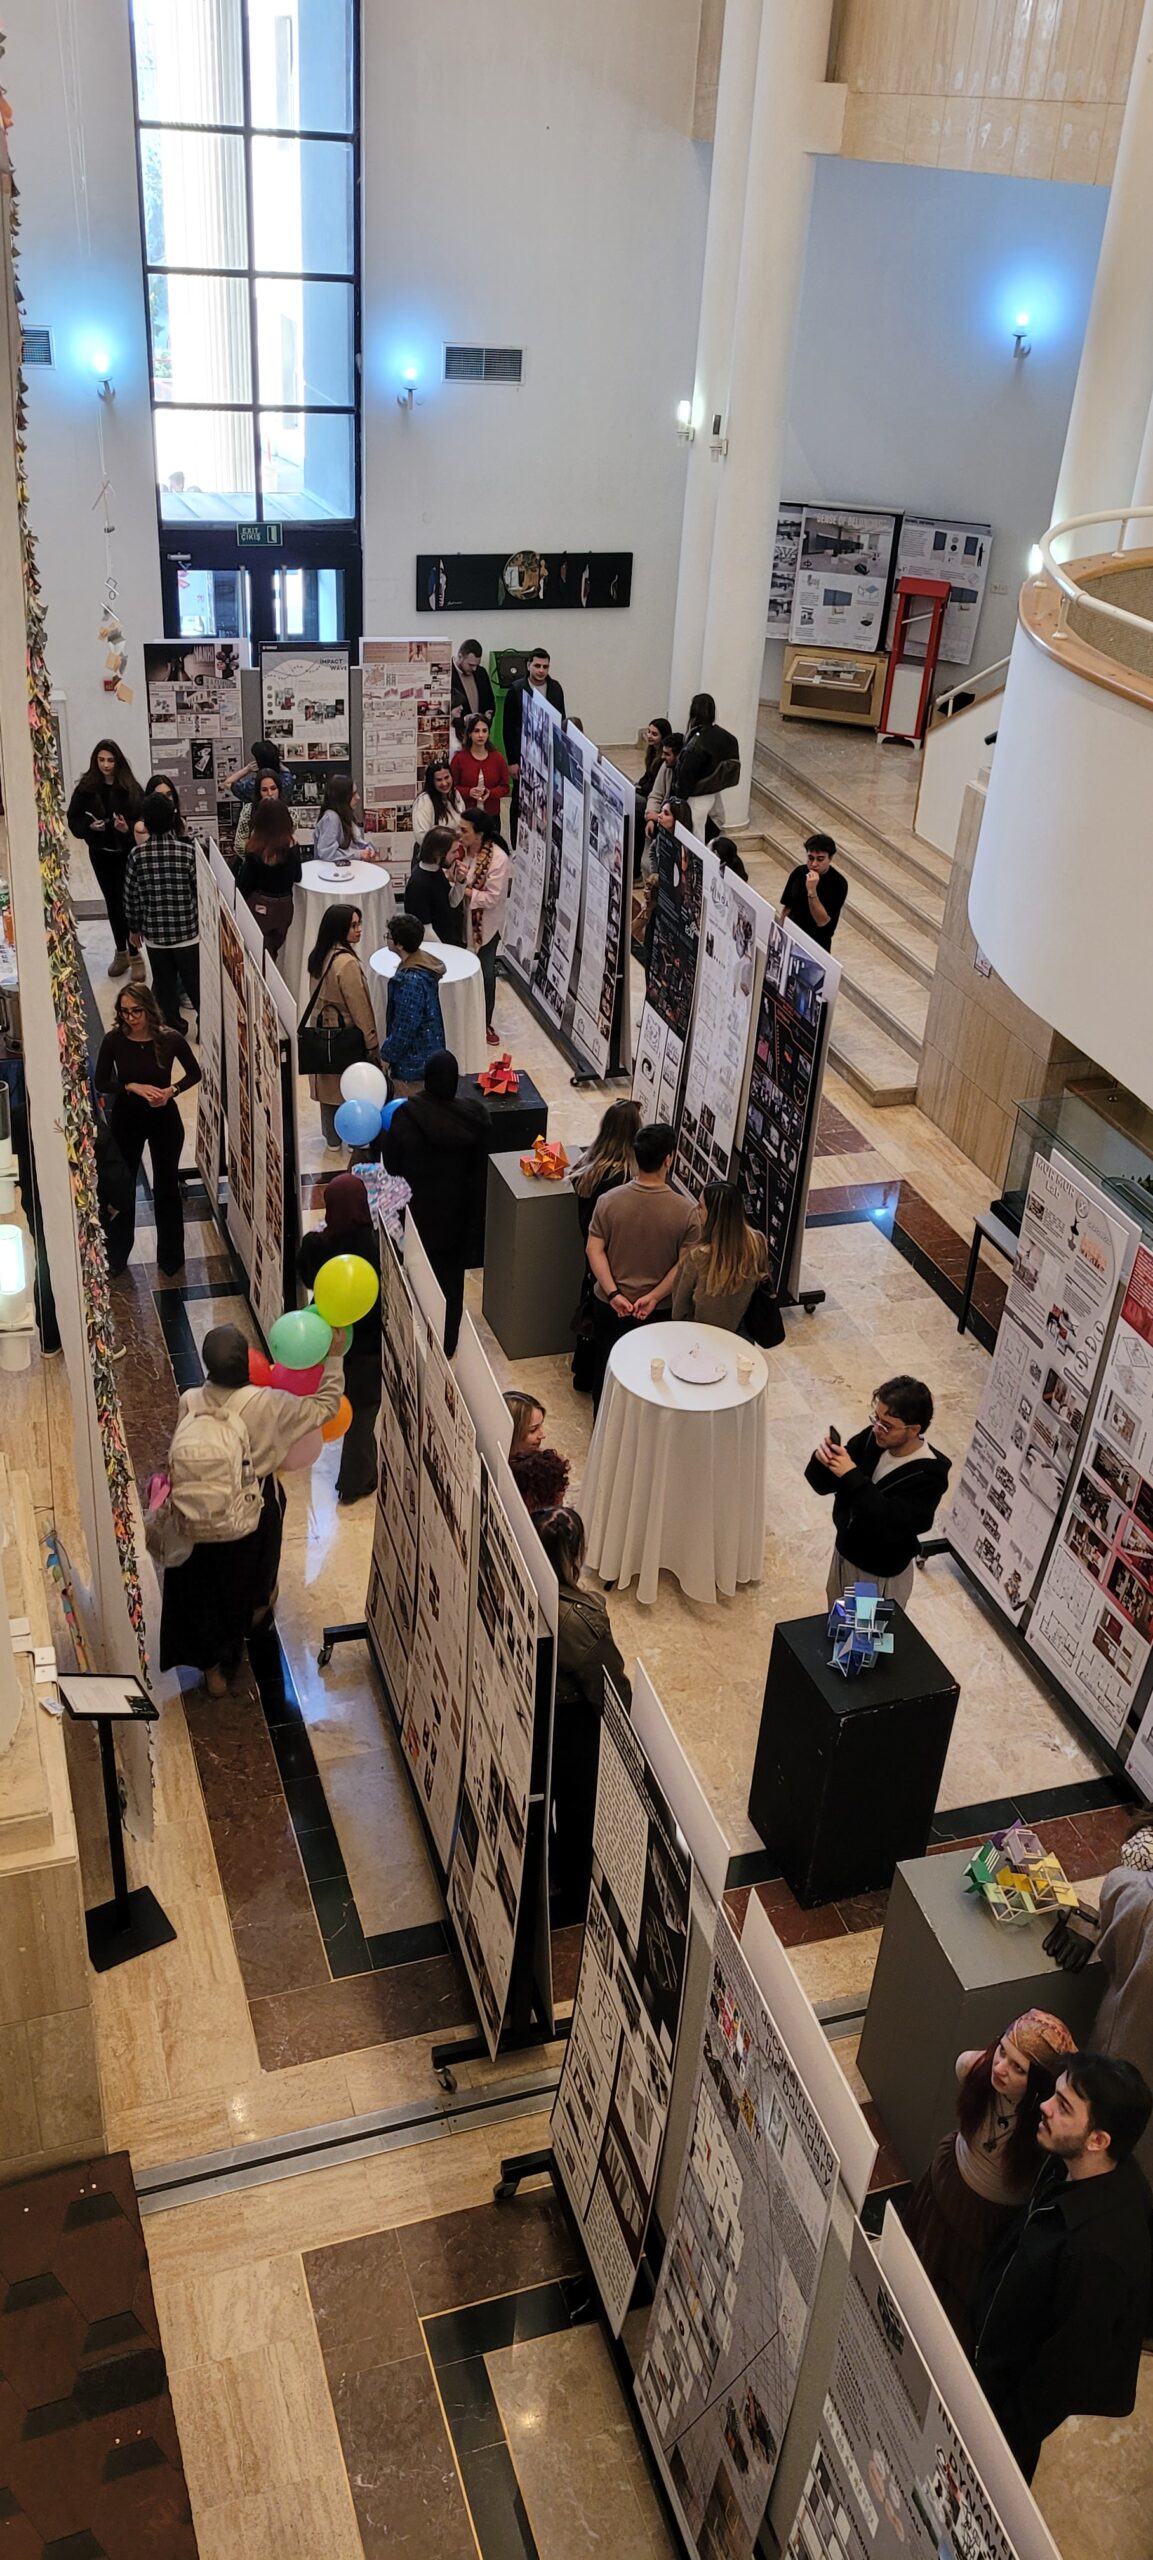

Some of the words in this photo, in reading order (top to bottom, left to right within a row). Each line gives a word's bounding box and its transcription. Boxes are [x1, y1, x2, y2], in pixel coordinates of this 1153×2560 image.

[761, 2009, 835, 2172] deconstructing
[764, 2038, 781, 2076] the
[782, 2076, 831, 2186] boundary
[949, 2451, 1001, 2560] DYNAM
